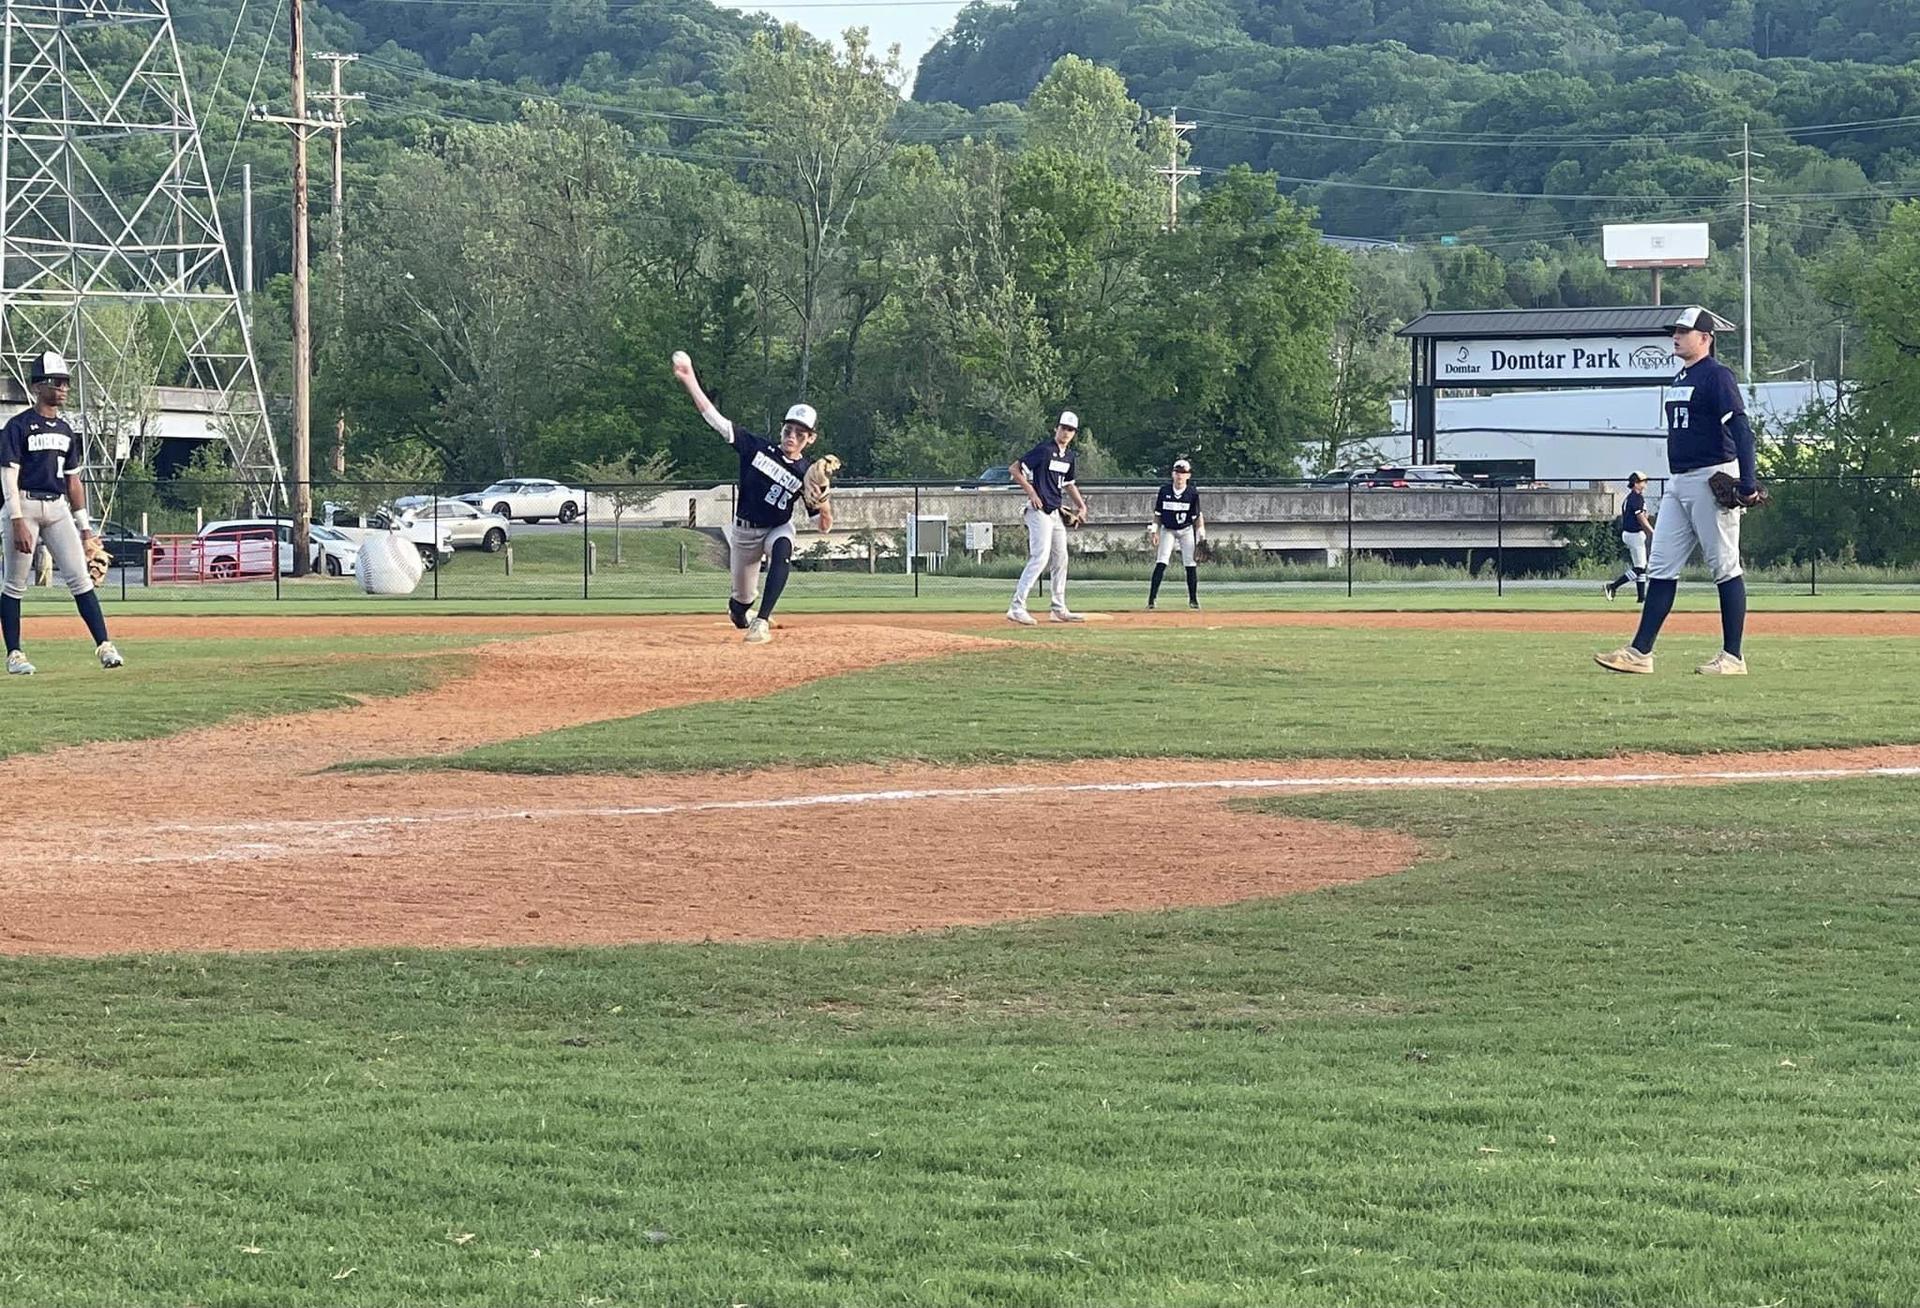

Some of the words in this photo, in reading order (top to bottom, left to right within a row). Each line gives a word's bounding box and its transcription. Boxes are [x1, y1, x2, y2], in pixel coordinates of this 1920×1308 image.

[1445, 364, 1481, 373] Domtar
[1490, 349, 1566, 372] Domtar
[1572, 348, 1620, 370] Park
[1672, 406, 1689, 429] 17
